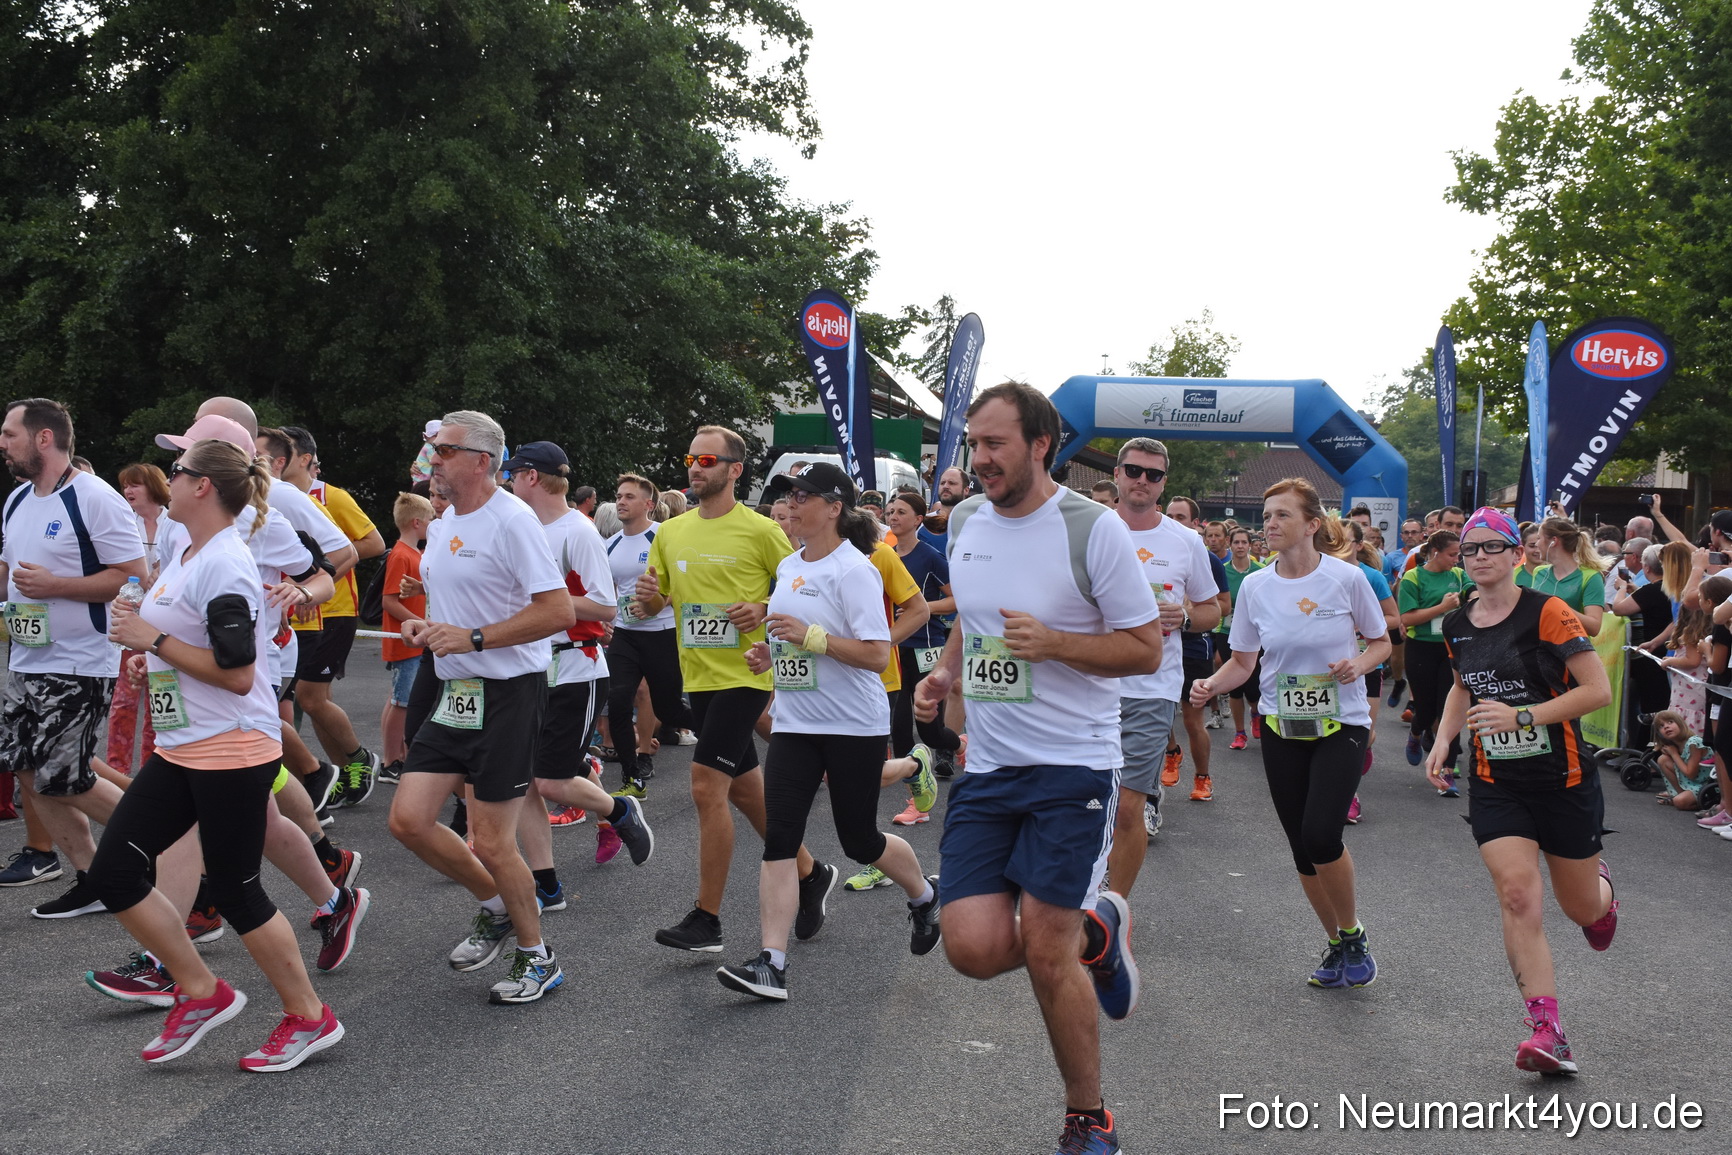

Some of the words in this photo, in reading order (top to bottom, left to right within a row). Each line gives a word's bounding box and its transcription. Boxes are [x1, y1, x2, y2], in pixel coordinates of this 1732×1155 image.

[1581, 340, 1659, 370] Hervis
[1590, 363, 1621, 371] SPORTS
[1189, 393, 1215, 403] Fischer
[1170, 408, 1245, 424] firmenlauf
[799, 590, 819, 598] NEUMARKT
[8, 617, 42, 635] 1875
[687, 618, 730, 636] 1227
[925, 648, 943, 662] 81
[774, 658, 809, 677] 1335
[967, 657, 1019, 685] 1469
[1460, 669, 1498, 685] HECK
[1470, 679, 1526, 695] DESIGN
[1283, 689, 1331, 707] 1354
[1490, 725, 1538, 745] 1013
[1503, 742, 1538, 751] Ann-Christin
